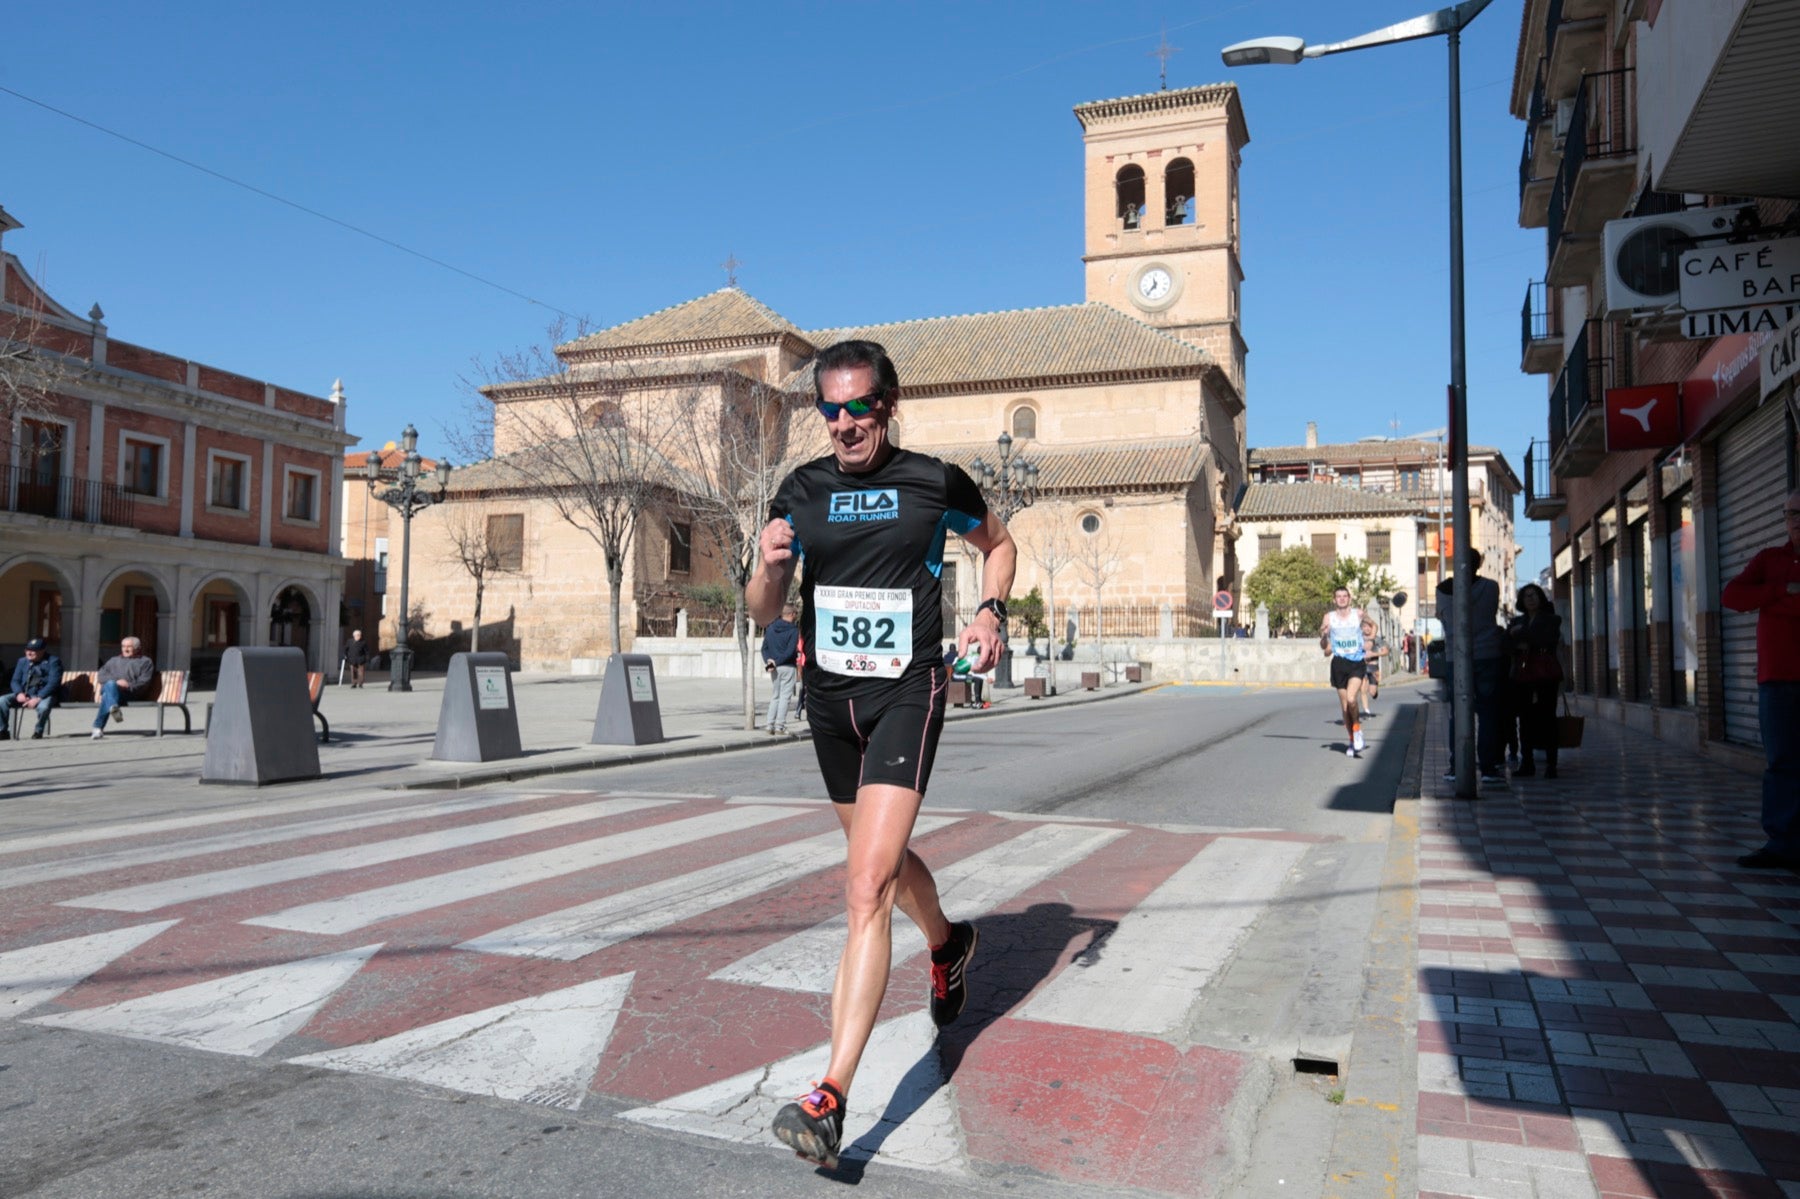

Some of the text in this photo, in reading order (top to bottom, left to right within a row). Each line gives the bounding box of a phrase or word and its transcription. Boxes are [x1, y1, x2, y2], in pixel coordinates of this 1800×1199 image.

[1685, 246, 1773, 276] CAFÉ
[834, 492, 894, 512] FILA
[828, 510, 899, 523] ROAD RUNNER
[837, 590, 853, 599] GRAN
[855, 591, 877, 600] PREMIO
[878, 592, 885, 600] DE
[887, 592, 907, 601] FONDO
[831, 615, 895, 649] 582
